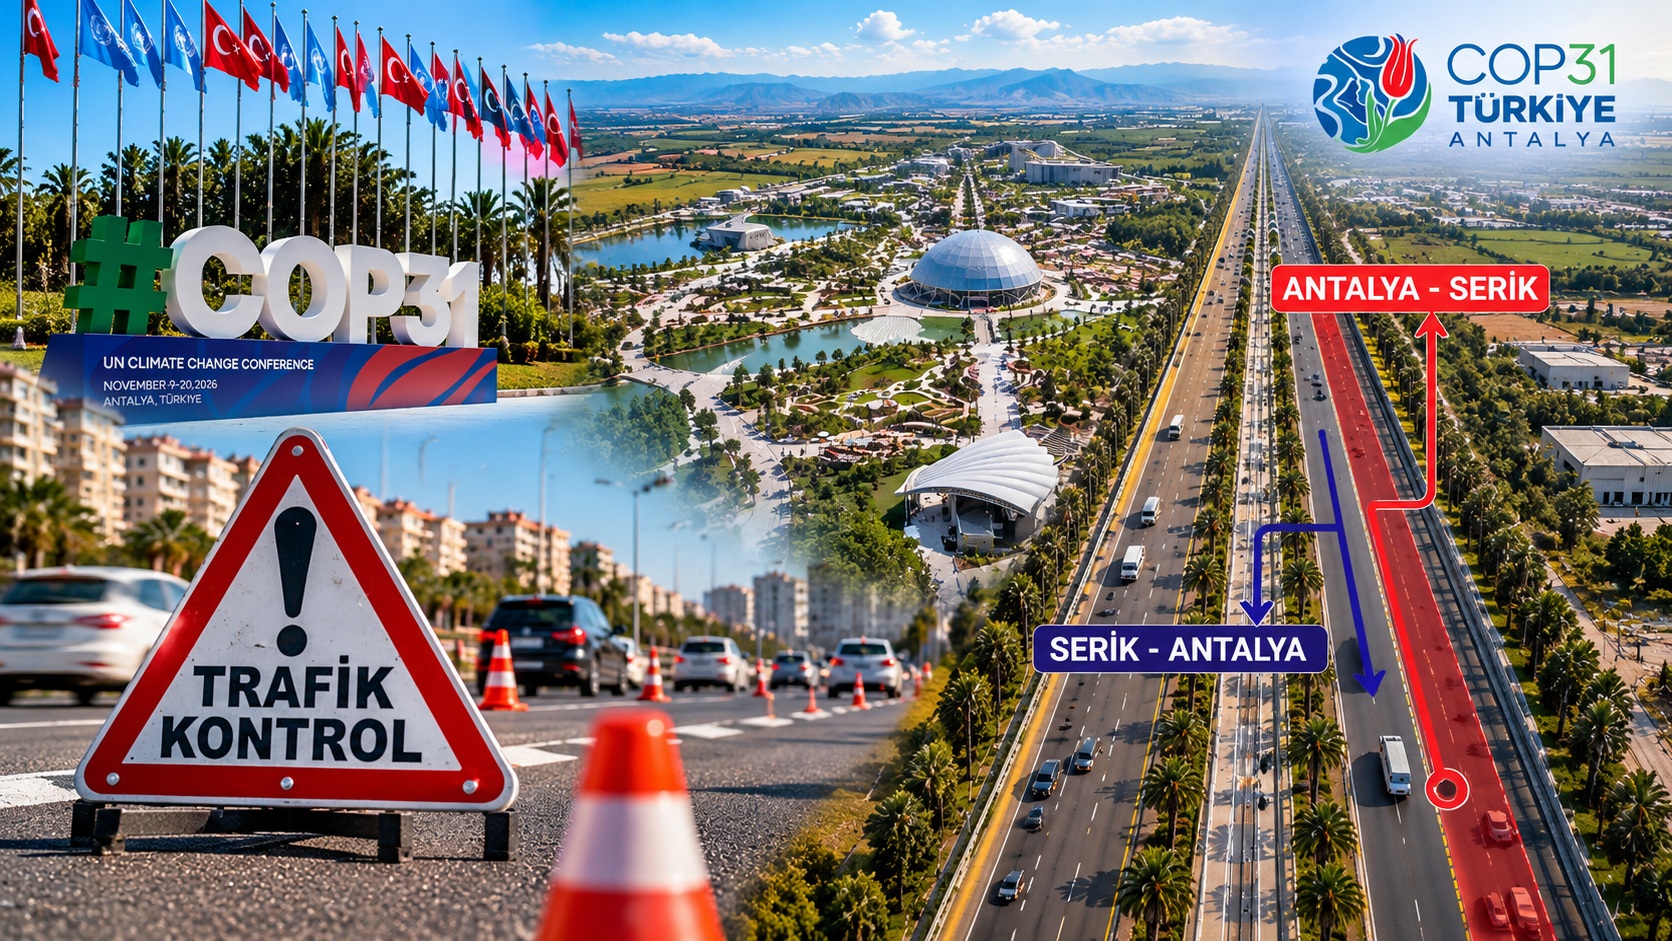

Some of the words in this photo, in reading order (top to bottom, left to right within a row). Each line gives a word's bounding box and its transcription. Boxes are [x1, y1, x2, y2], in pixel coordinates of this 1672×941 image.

[63, 214, 480, 348] #COP31
[103, 356, 125, 369] UN
[128, 356, 184, 369] CLIMATE
[187, 357, 239, 370] CHANGE
[241, 359, 315, 370] CONFERENCE
[103, 394, 158, 407] ANTALYA,
[193, 655, 395, 709] TRAFİK
[160, 716, 423, 763] KONTROL
